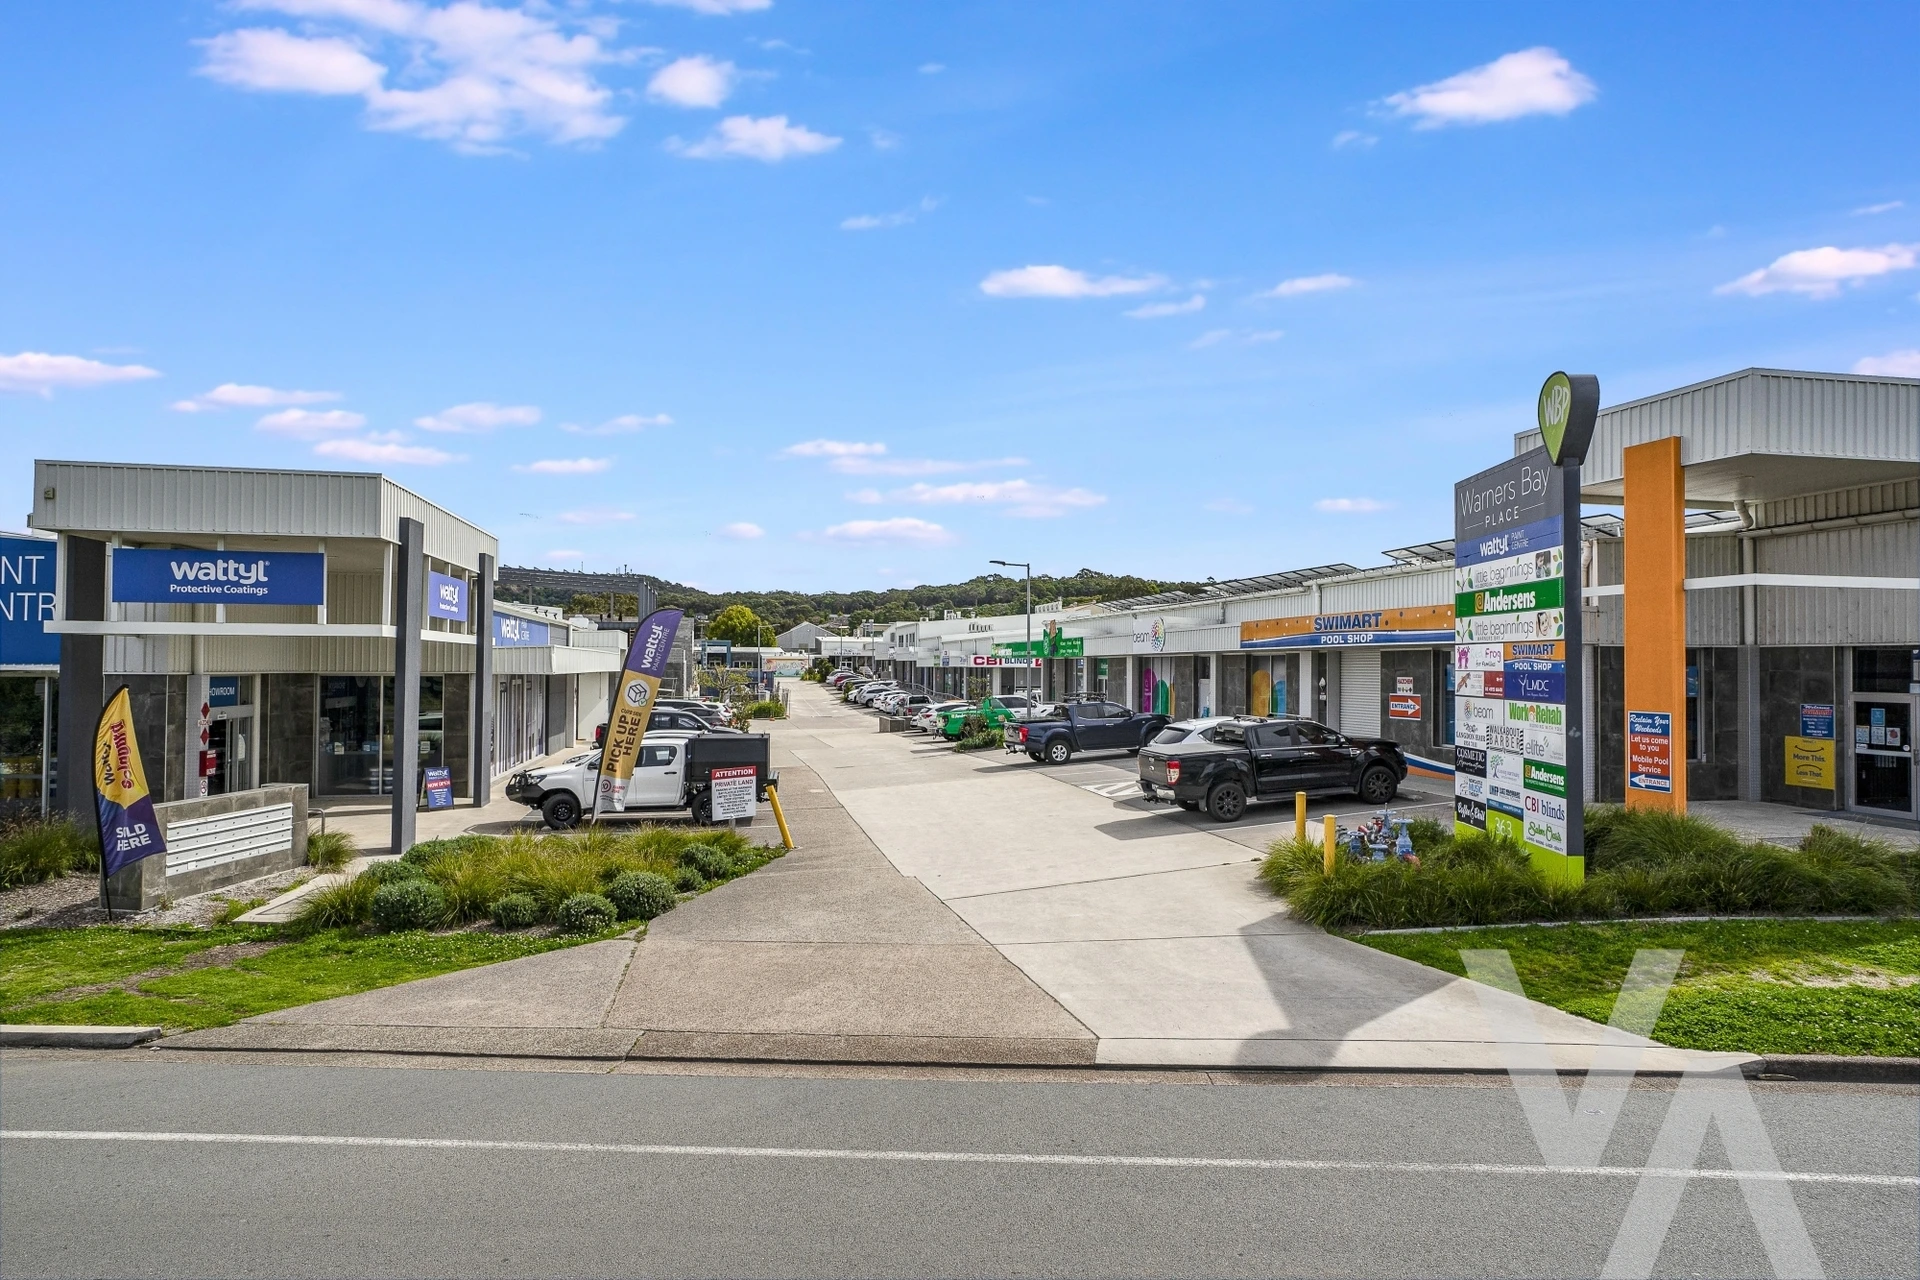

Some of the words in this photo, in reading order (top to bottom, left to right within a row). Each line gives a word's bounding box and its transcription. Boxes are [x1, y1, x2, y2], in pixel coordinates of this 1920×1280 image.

[1543, 385, 1569, 427] WBP
[1460, 480, 1516, 517] Warners
[1521, 466, 1550, 496] Bay
[1485, 505, 1519, 528] PLACE
[1479, 534, 1509, 557] wattyl
[170, 559, 269, 584] wattyl
[1489, 561, 1534, 585] beginnings
[170, 584, 222, 593] Protective
[224, 585, 268, 596] Coatings
[1483, 589, 1536, 613] Andersens
[1314, 612, 1382, 632] SWIMART
[1489, 620, 1534, 640] beginnings
[641, 625, 663, 668] wattyl
[1321, 635, 1345, 644] POOL
[1347, 634, 1373, 643] SHOP
[1485, 648, 1501, 663] Frog
[1512, 643, 1555, 656] SWIMART
[973, 656, 1002, 666] CBI
[209, 687, 235, 696] HOWROOM
[1473, 702, 1494, 719] beam
[1509, 702, 1529, 721] Work
[1535, 704, 1562, 726] Rehab
[1630, 714, 1652, 724] Reclaim
[1654, 715, 1669, 727] Your
[1634, 724, 1662, 734] Weekends
[622, 718, 641, 756] HERE
[1489, 725, 1520, 737] WALKABOUT
[1631, 735, 1641, 743] Let
[606, 738, 624, 772] PICK
[616, 715, 628, 735] UP
[1489, 734, 1521, 749] BARBER
[1525, 739, 1545, 757] elite
[1456, 747, 1485, 762] COSMETIC
[1632, 755, 1652, 764] Mobile
[1654, 757, 1669, 765] Pool
[1793, 753, 1809, 761] More
[715, 768, 754, 778] ATTENTION
[1531, 765, 1564, 786] Andersens
[1638, 764, 1661, 774] Service
[715, 780, 737, 788] PRIVATE
[1638, 778, 1668, 786] ENTRANCE
[1525, 795, 1539, 813] CBI
[1541, 799, 1565, 821] blinds
[1494, 816, 1512, 838] 363
[117, 834, 152, 852] HERE
